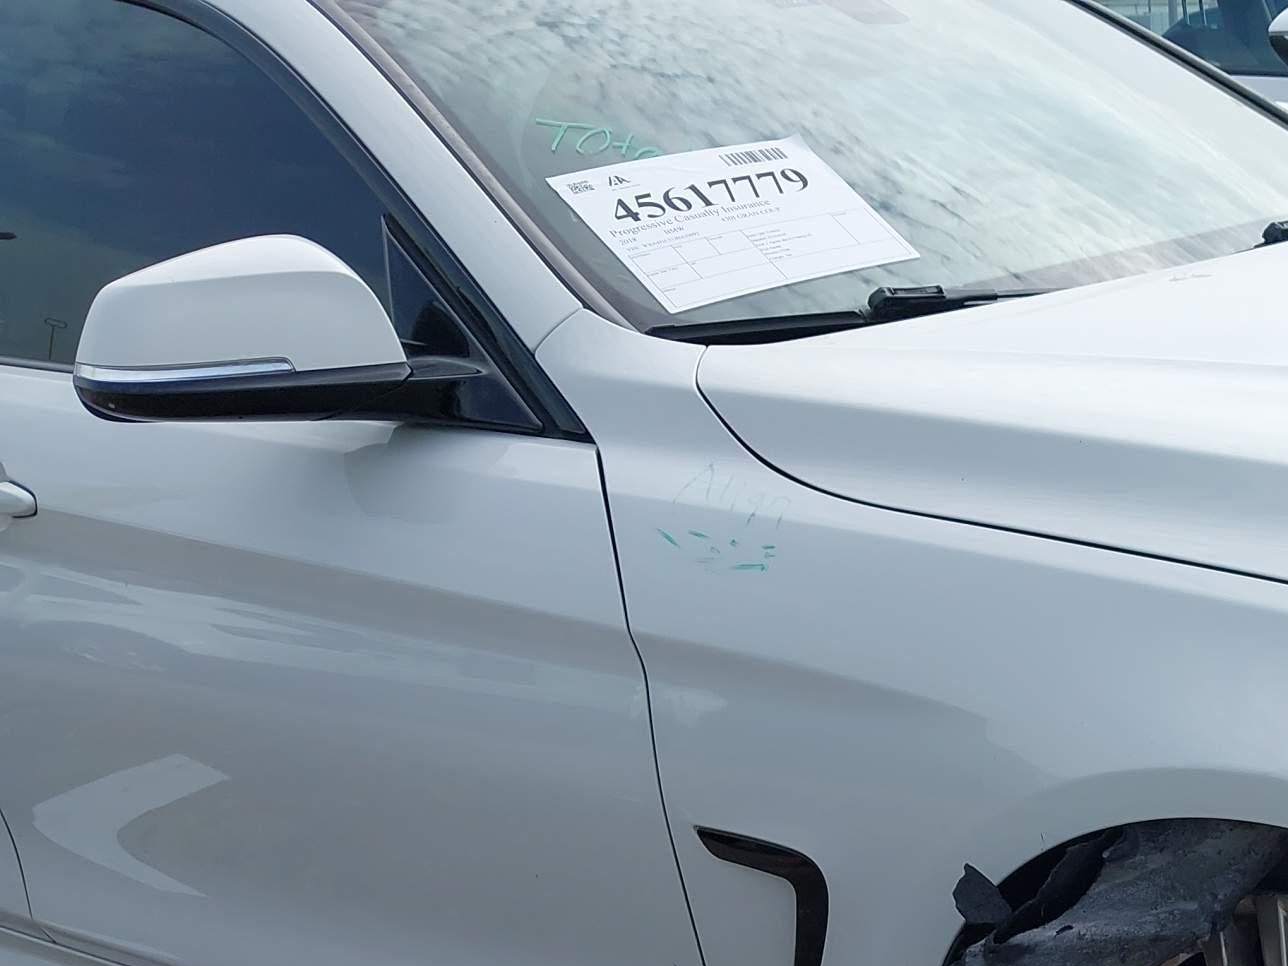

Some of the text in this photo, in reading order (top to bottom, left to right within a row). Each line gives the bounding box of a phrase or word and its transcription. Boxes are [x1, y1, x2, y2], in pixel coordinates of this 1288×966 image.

[614, 168, 809, 222] 45617779
[609, 200, 772, 238] Progressive Casualty Insurance
